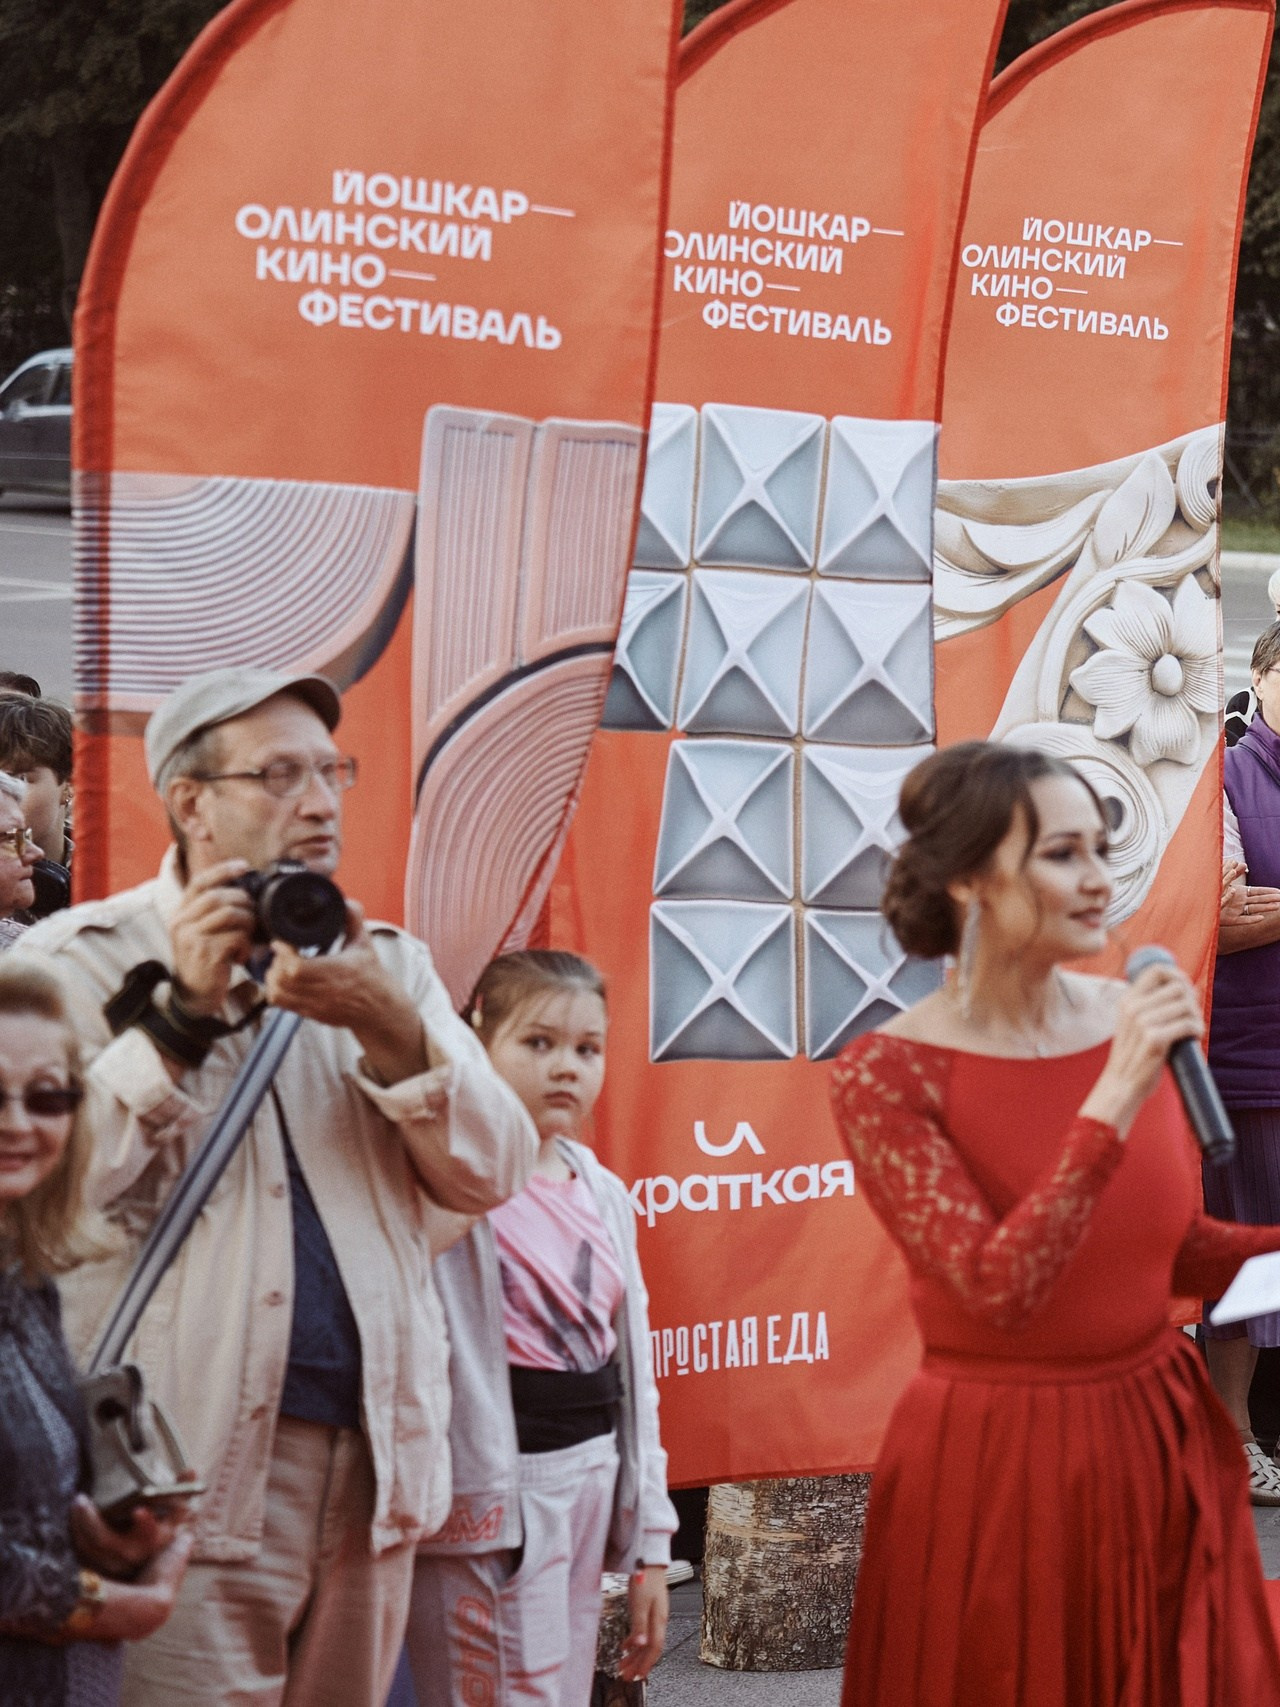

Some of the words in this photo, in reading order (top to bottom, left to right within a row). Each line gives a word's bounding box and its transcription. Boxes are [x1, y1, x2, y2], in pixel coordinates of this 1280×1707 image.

[234, 203, 493, 262] ОЛИНСКИЙ
[663, 229, 844, 275] ОЛИНСКИЙ
[961, 243, 1127, 280] ОЛИНСКИЙ
[298, 288, 562, 350] ФЕСТИВАЛЬ
[702, 298, 892, 346] ФЕСТИВАЛЬ
[995, 301, 1169, 341] ФЕСТИВАЛЬ
[650, 1316, 758, 1379] ПРОСТАЯ
[767, 1311, 831, 1365] ЕДА
